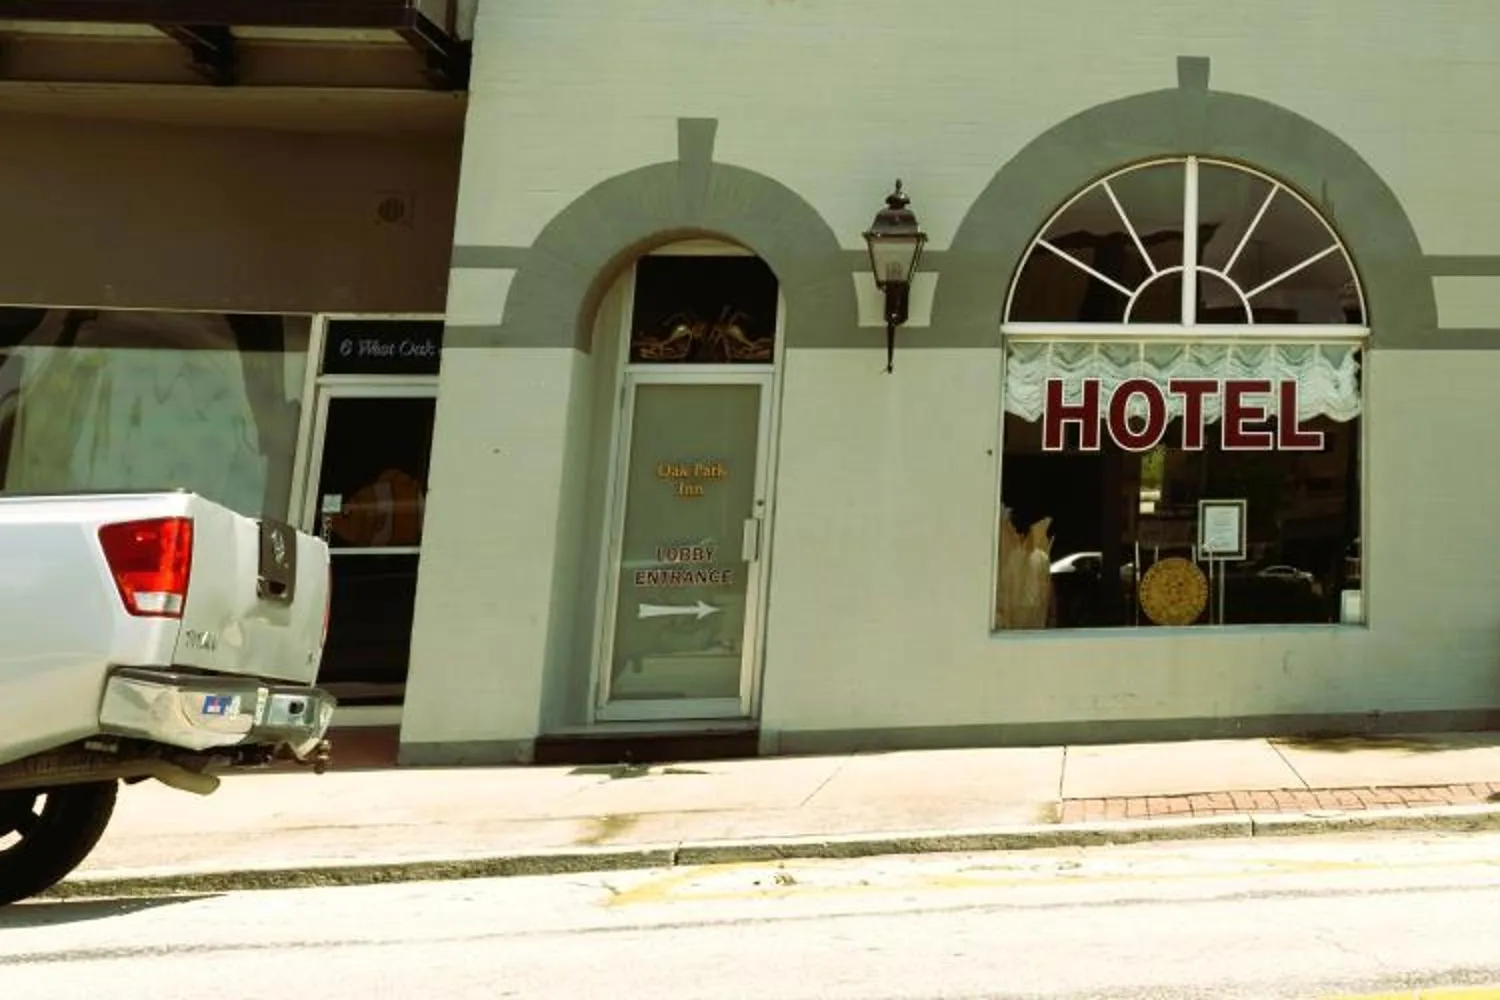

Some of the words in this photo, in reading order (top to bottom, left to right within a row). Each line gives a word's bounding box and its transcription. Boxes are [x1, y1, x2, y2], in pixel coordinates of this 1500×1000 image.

[1042, 377, 1324, 452] HOTEL
[679, 482, 704, 497] Inn
[656, 545, 717, 563] LOBBY
[635, 569, 733, 588] ENTRANCE
